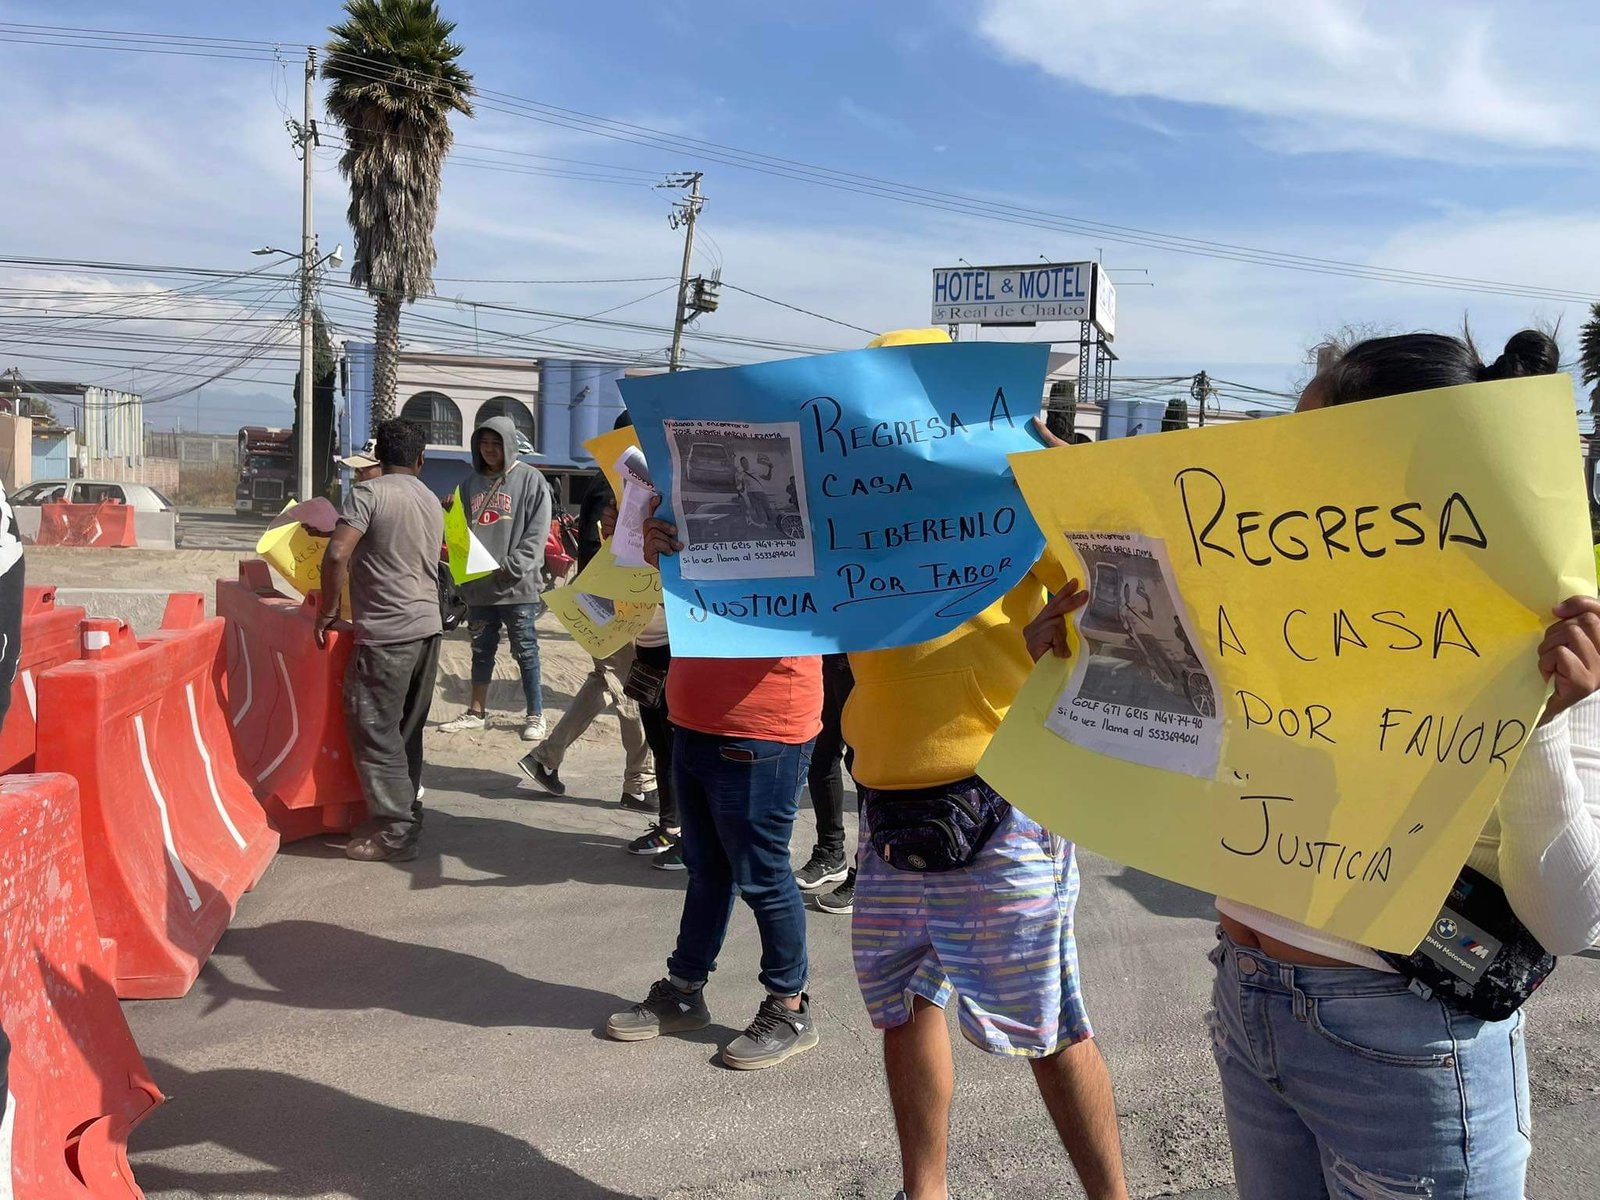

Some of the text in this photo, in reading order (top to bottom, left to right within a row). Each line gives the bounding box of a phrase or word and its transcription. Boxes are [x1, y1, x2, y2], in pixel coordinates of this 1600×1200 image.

[935, 272, 995, 302] HOTEL
[1001, 278, 1014, 294] &
[1019, 267, 1085, 299] MOTEL
[950, 303, 1085, 319] Real de Chalco
[800, 387, 1014, 458] REGRESA A
[821, 472, 913, 498] CASA
[828, 507, 1016, 551] LIBERENLO
[1174, 467, 1488, 567] REGRESA
[688, 543, 709, 551] GOLF
[712, 542, 728, 551] GTI
[742, 552, 751, 561] al
[838, 556, 1012, 598] POR FABOR
[689, 589, 818, 623] JUSTICIA
[1217, 604, 1481, 662] A CASA
[1069, 711, 1079, 722] lo
[1081, 719, 1097, 728] vez
[1101, 718, 1129, 736] llama
[1133, 726, 1144, 738] al
[1148, 728, 1199, 746] 5533694061
[1071, 697, 1203, 729] GOLF GTI GRIS NGV-74-40
[1378, 708, 1527, 773] FAVOR
[1425, 935, 1476, 972] BMW Motorsport
